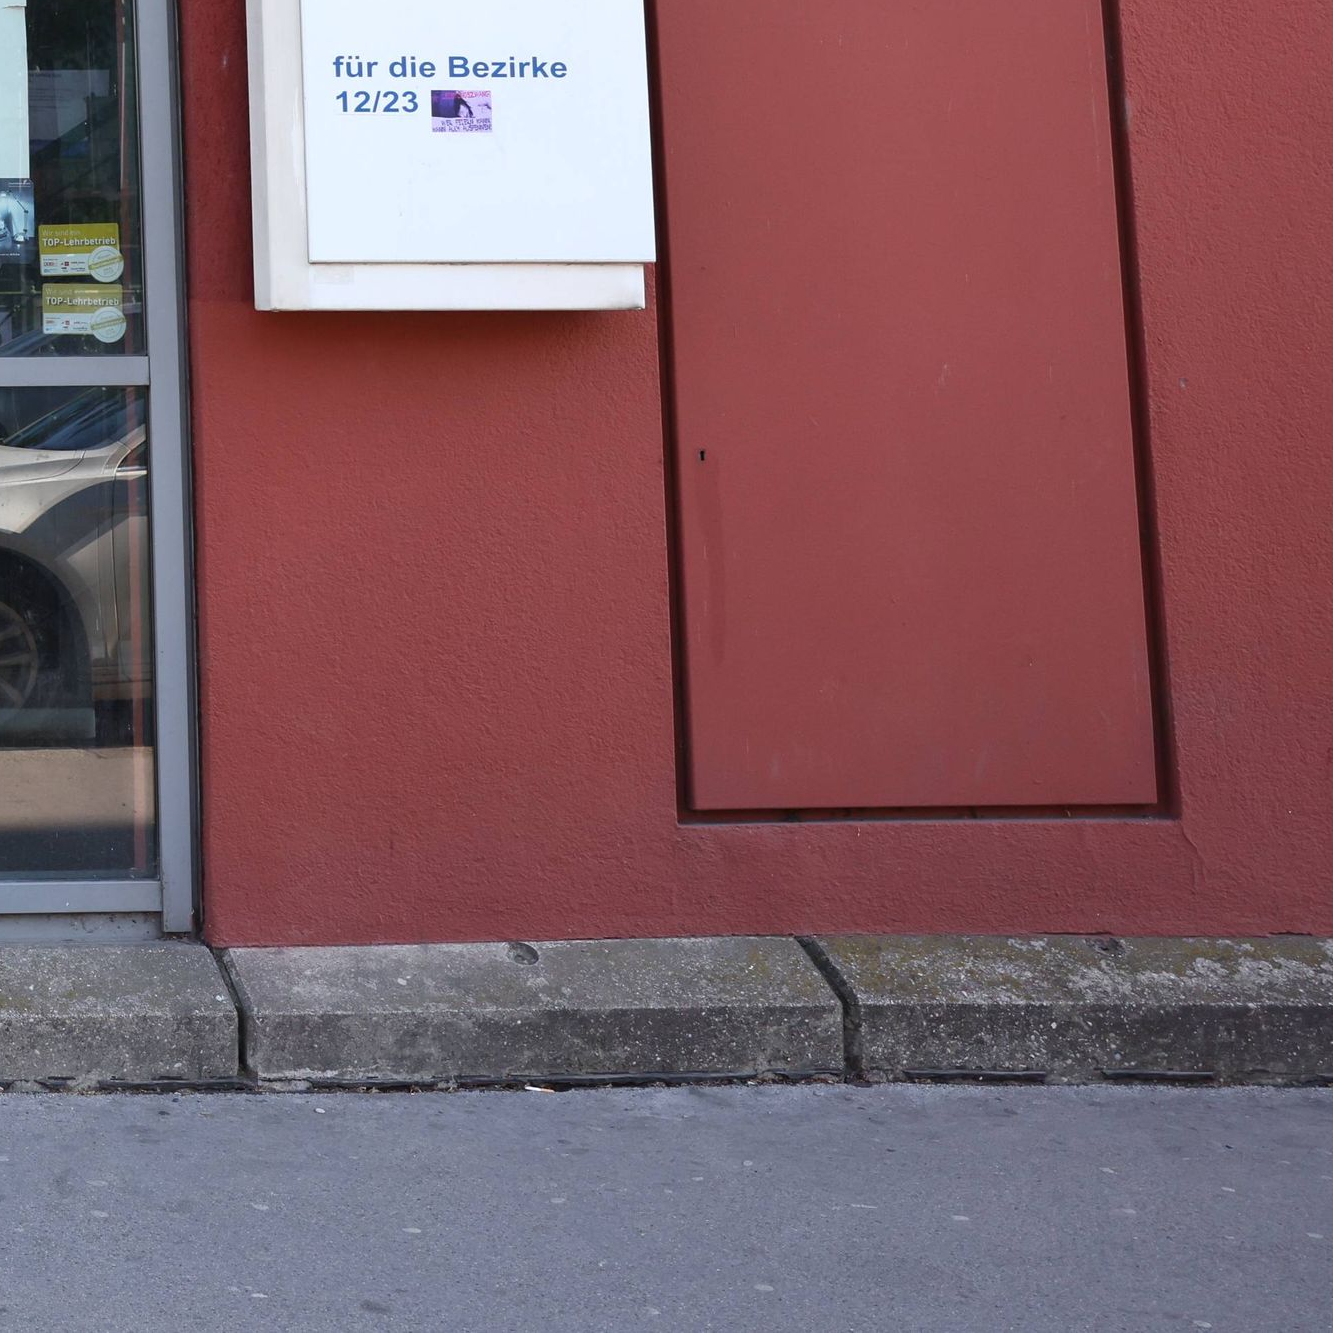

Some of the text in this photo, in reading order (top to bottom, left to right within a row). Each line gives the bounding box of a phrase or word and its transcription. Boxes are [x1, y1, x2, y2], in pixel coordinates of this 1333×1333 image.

[332, 55, 567, 78] für die Bezirke
[335, 90, 419, 113] 12/23
[42, 237, 116, 247] TOP-Lehrbetrieb
[45, 297, 119, 306] TOP-Lehrbetrieb
